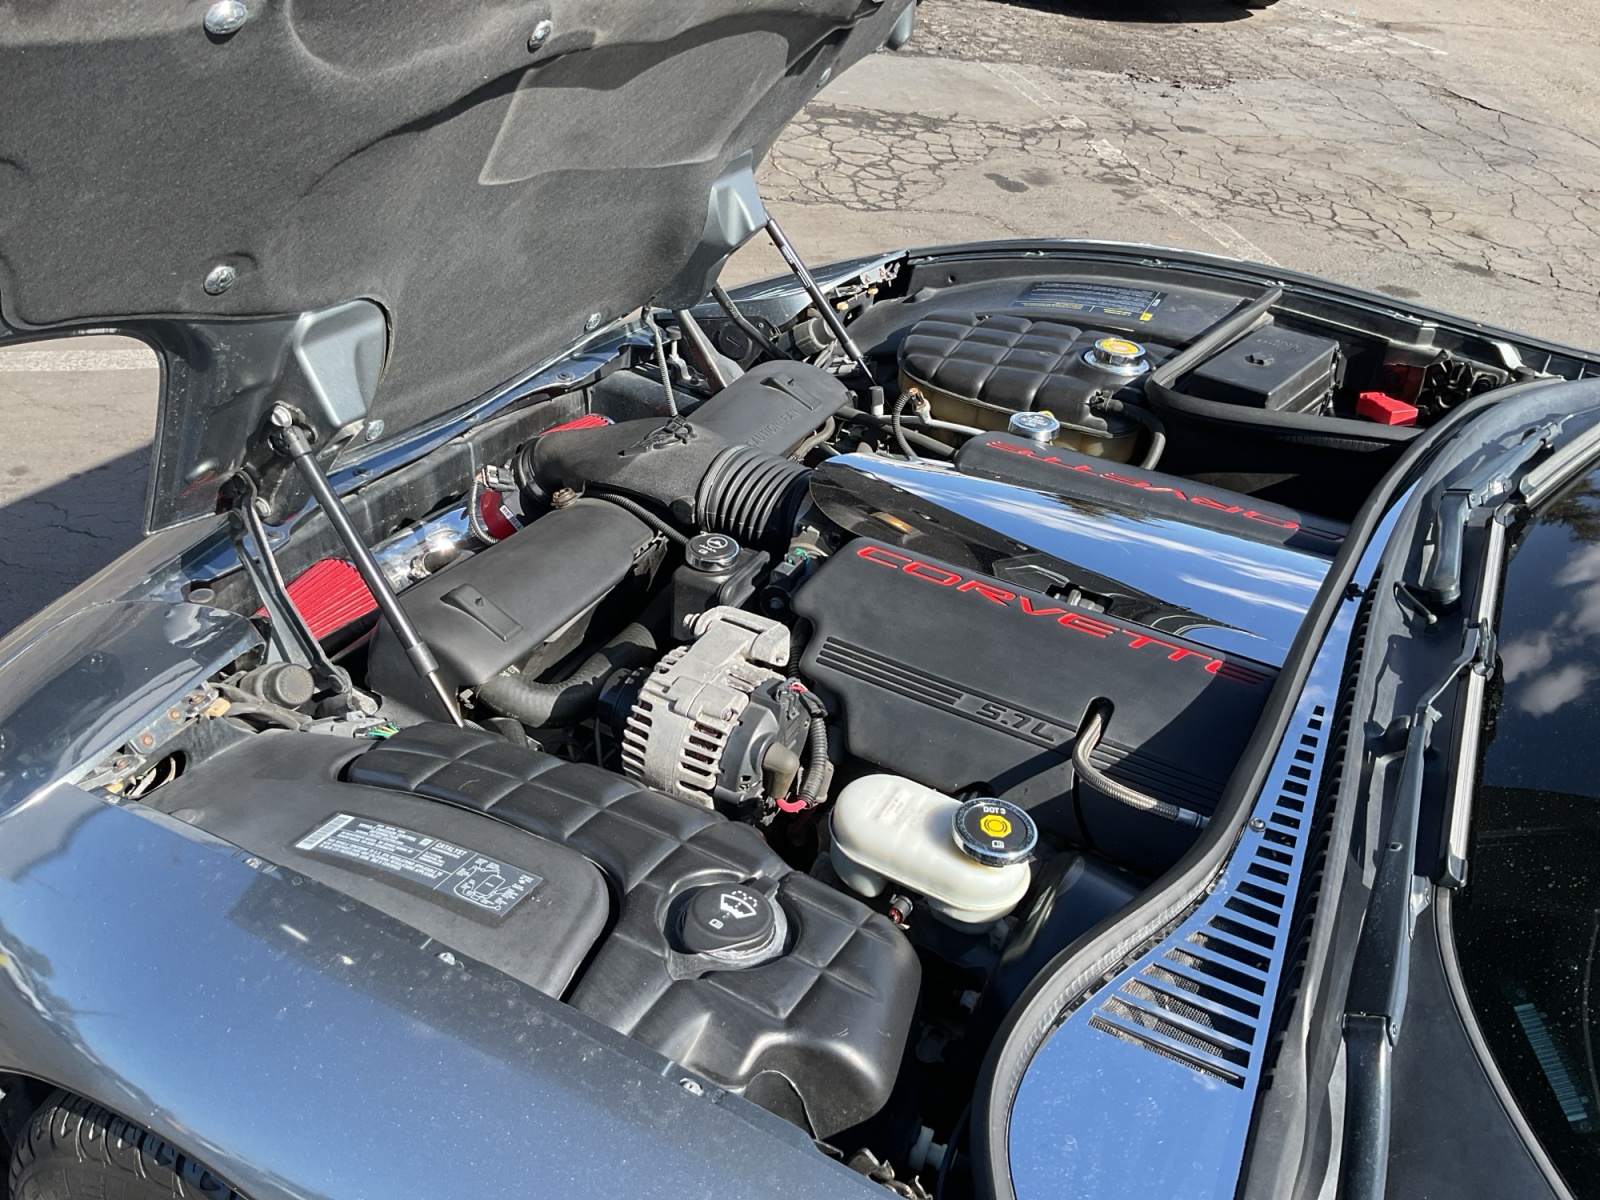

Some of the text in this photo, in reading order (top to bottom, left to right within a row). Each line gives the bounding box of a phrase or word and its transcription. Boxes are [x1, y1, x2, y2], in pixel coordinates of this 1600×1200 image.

[745, 408, 799, 448] CAUTION FAN
[985, 440, 1346, 542] CORVETTE
[857, 545, 1272, 685] CORVETTE
[975, 701, 1055, 742] 5.7L
[982, 805, 1007, 815] DOT 3
[434, 842, 468, 857] CATALYST
